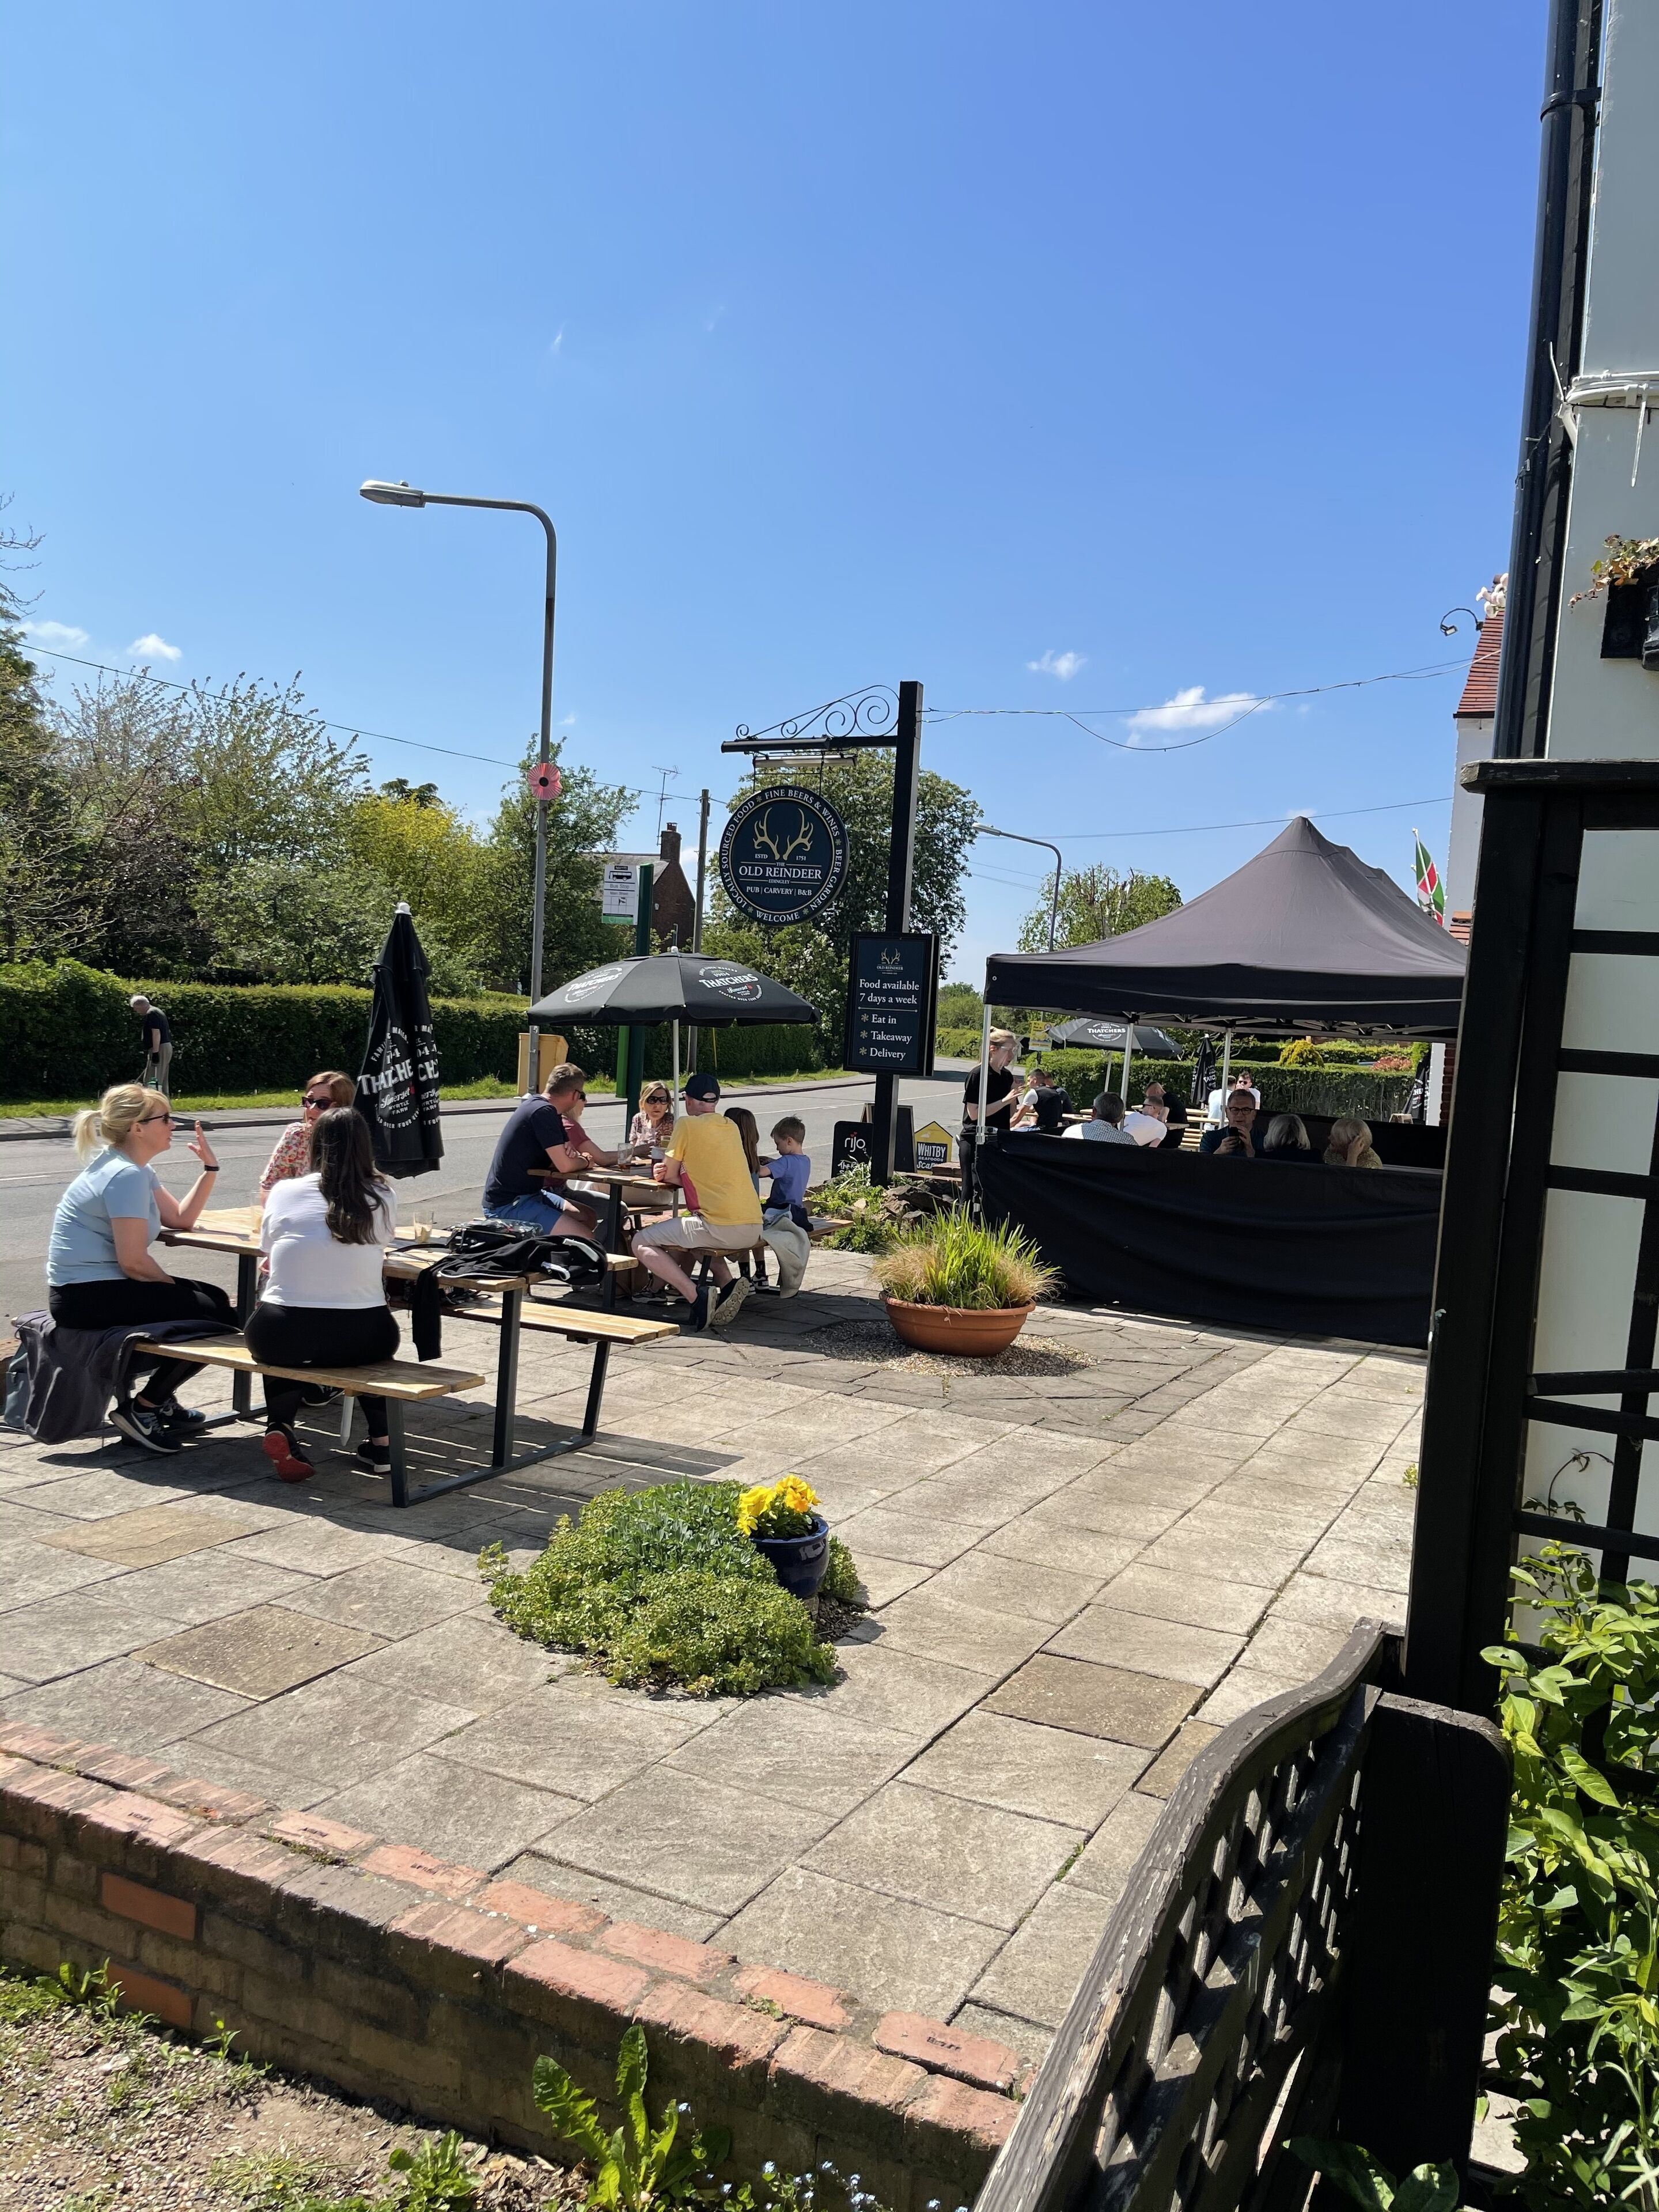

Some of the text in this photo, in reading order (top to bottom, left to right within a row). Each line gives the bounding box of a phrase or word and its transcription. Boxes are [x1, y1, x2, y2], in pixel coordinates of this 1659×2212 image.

[764, 789, 840, 837] FINE BEERS & WINES
[721, 800, 755, 909] LOCALLY SOURCED FOOD
[738, 866, 823, 880] OLD REINDEER
[810, 849, 843, 911] BEER GARDEN
[764, 887, 793, 895] CARVERY
[797, 888, 812, 896] B&B
[755, 910, 801, 923] WELCOME
[699, 974, 759, 988] THATCHERS
[859, 979, 920, 991] Food available
[859, 993, 865, 1002] 7
[868, 993, 886, 1005] days
[895, 994, 918, 1005] week
[871, 1013, 897, 1024] Eat in
[870, 1030, 912, 1044] Takeaway
[869, 1047, 906, 1061] Delivery
[844, 1134, 866, 1153] rijo
[918, 1142, 946, 1158] WHITBY
